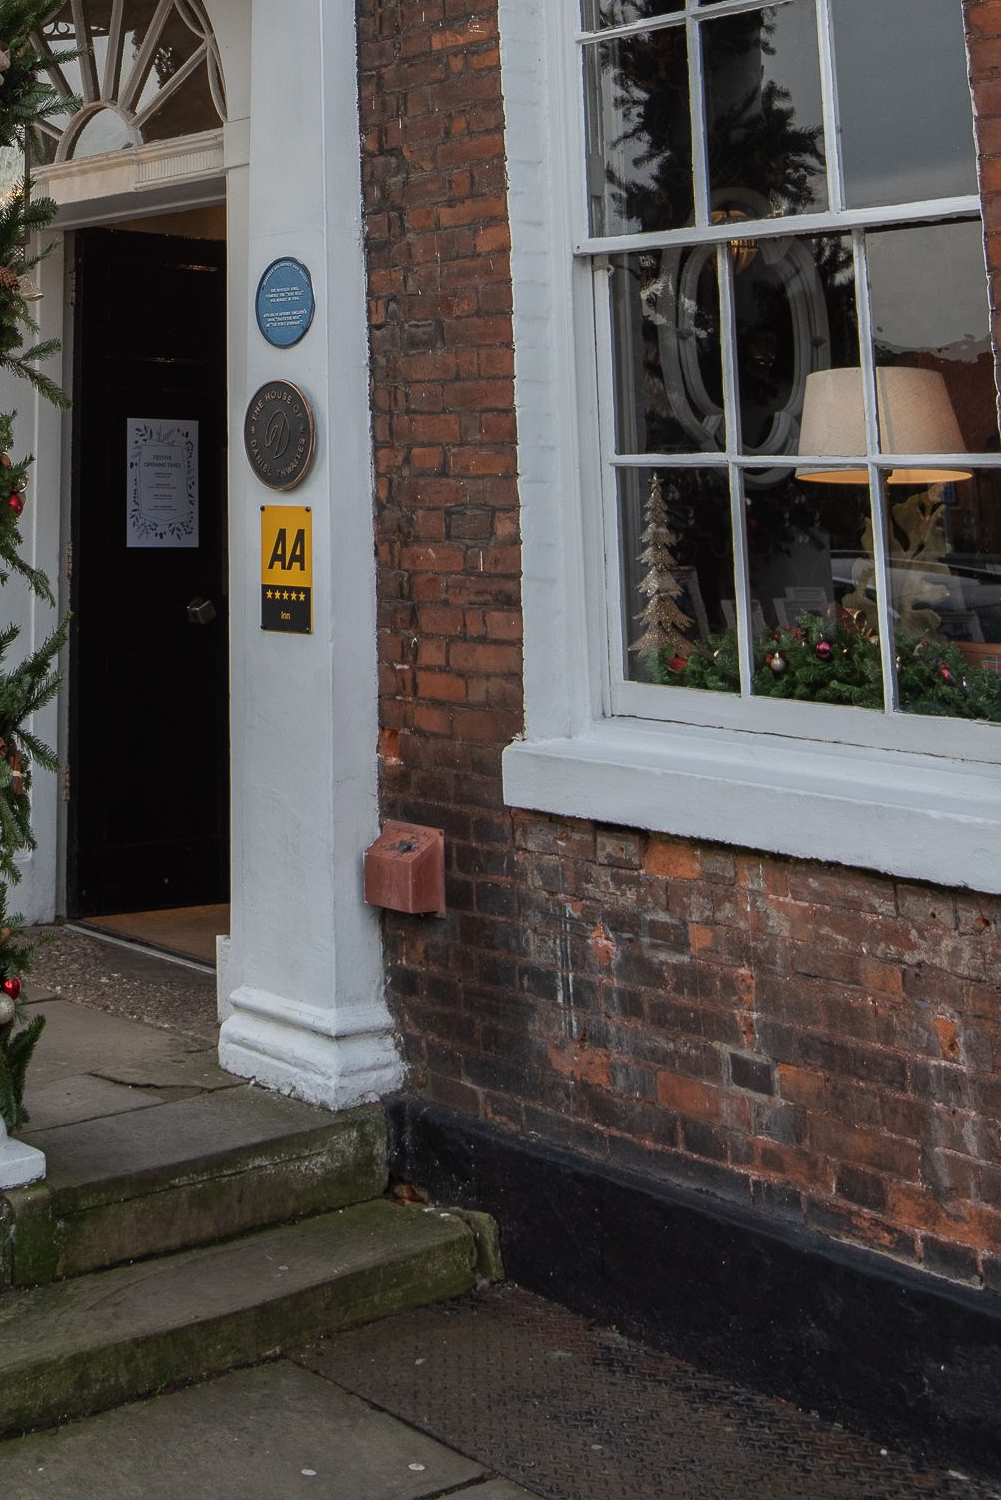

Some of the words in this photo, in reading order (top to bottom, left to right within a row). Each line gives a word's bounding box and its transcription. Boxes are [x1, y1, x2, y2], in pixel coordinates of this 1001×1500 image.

[252, 399, 264, 421] THE
[264, 390, 292, 404] HOUSE
[293, 404, 304, 420] OF
[250, 439, 272, 476] DANIEL
[275, 437, 306, 478] THWAITES
[268, 528, 306, 571] AA
[280, 611, 291, 620] Inn
